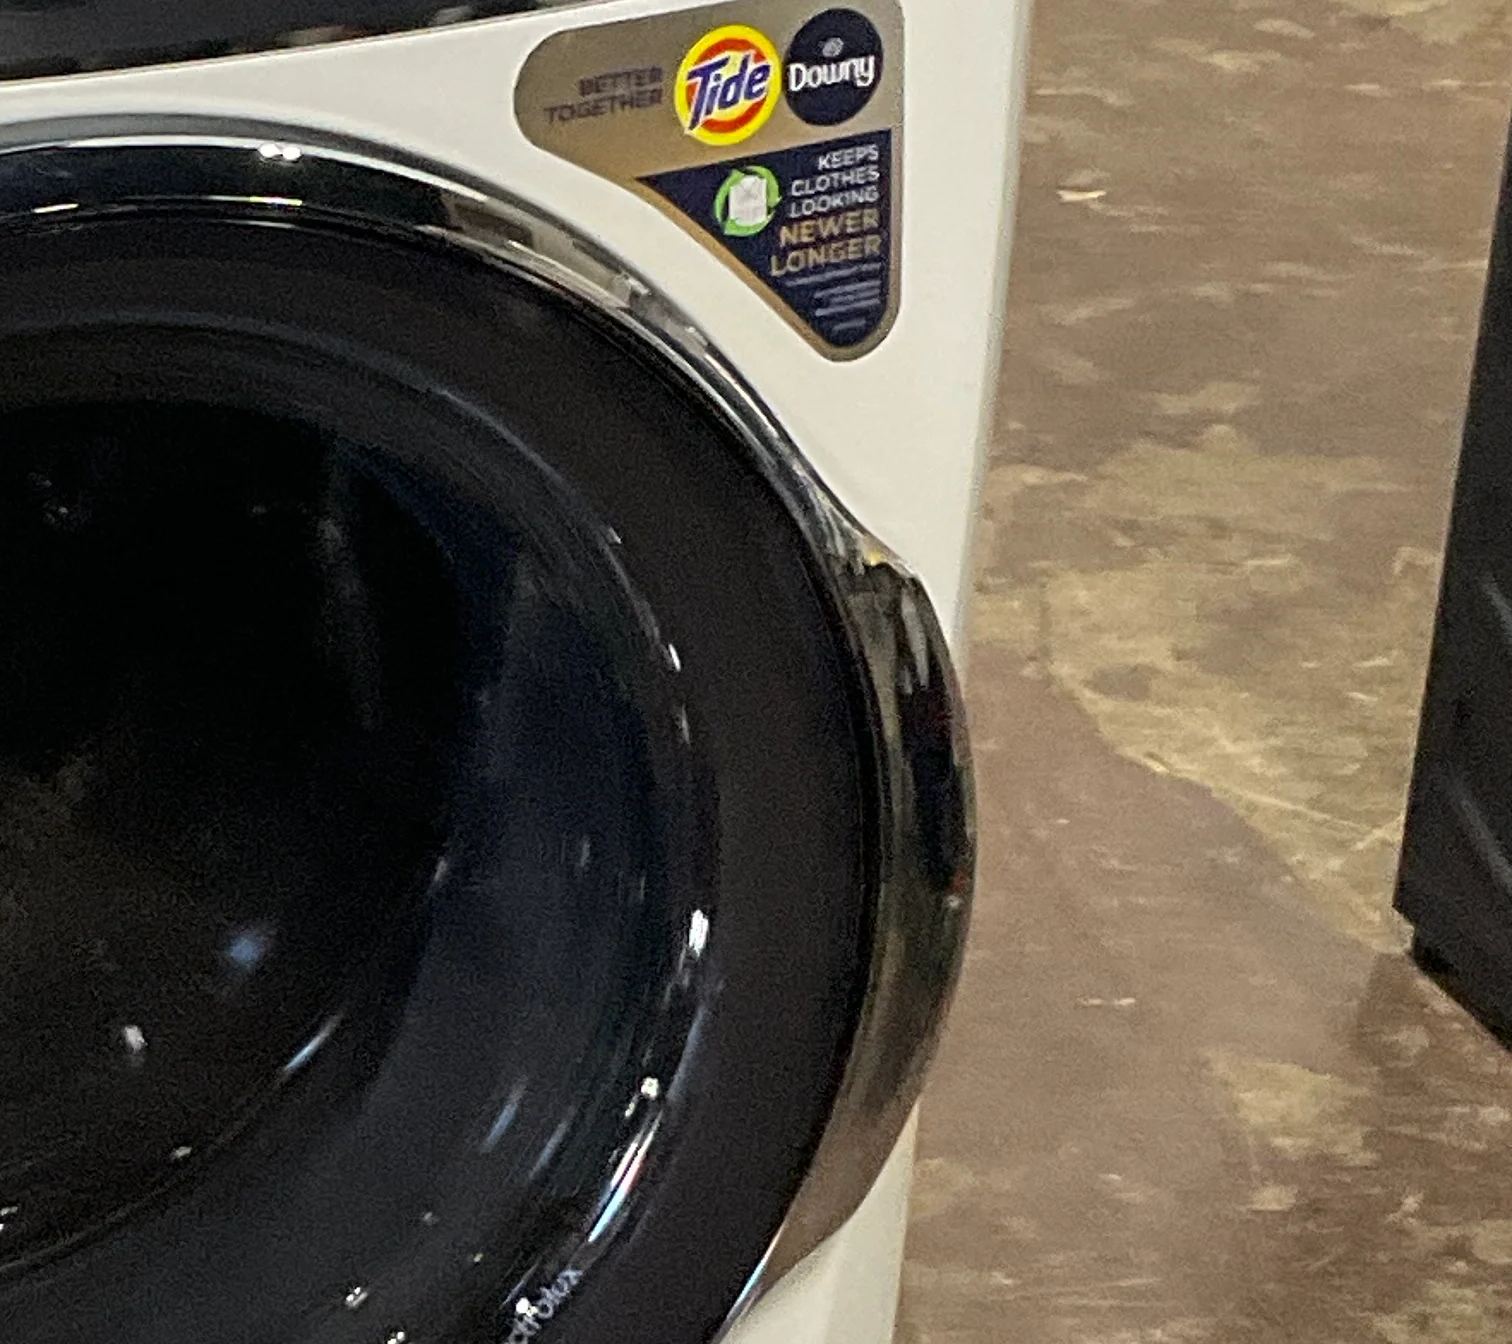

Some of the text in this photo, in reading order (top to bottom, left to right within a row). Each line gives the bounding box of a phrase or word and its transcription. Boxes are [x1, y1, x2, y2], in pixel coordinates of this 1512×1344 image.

[577, 66, 664, 97] BETTER
[788, 54, 876, 92] Downy
[543, 86, 664, 125] TOGETHER
[684, 50, 773, 138] Tide
[817, 144, 880, 172] KEEPS
[790, 169, 880, 197] CLOTHES
[789, 186, 880, 220] LOOKING
[779, 210, 880, 248] NEWER
[770, 236, 882, 278] LONGER
